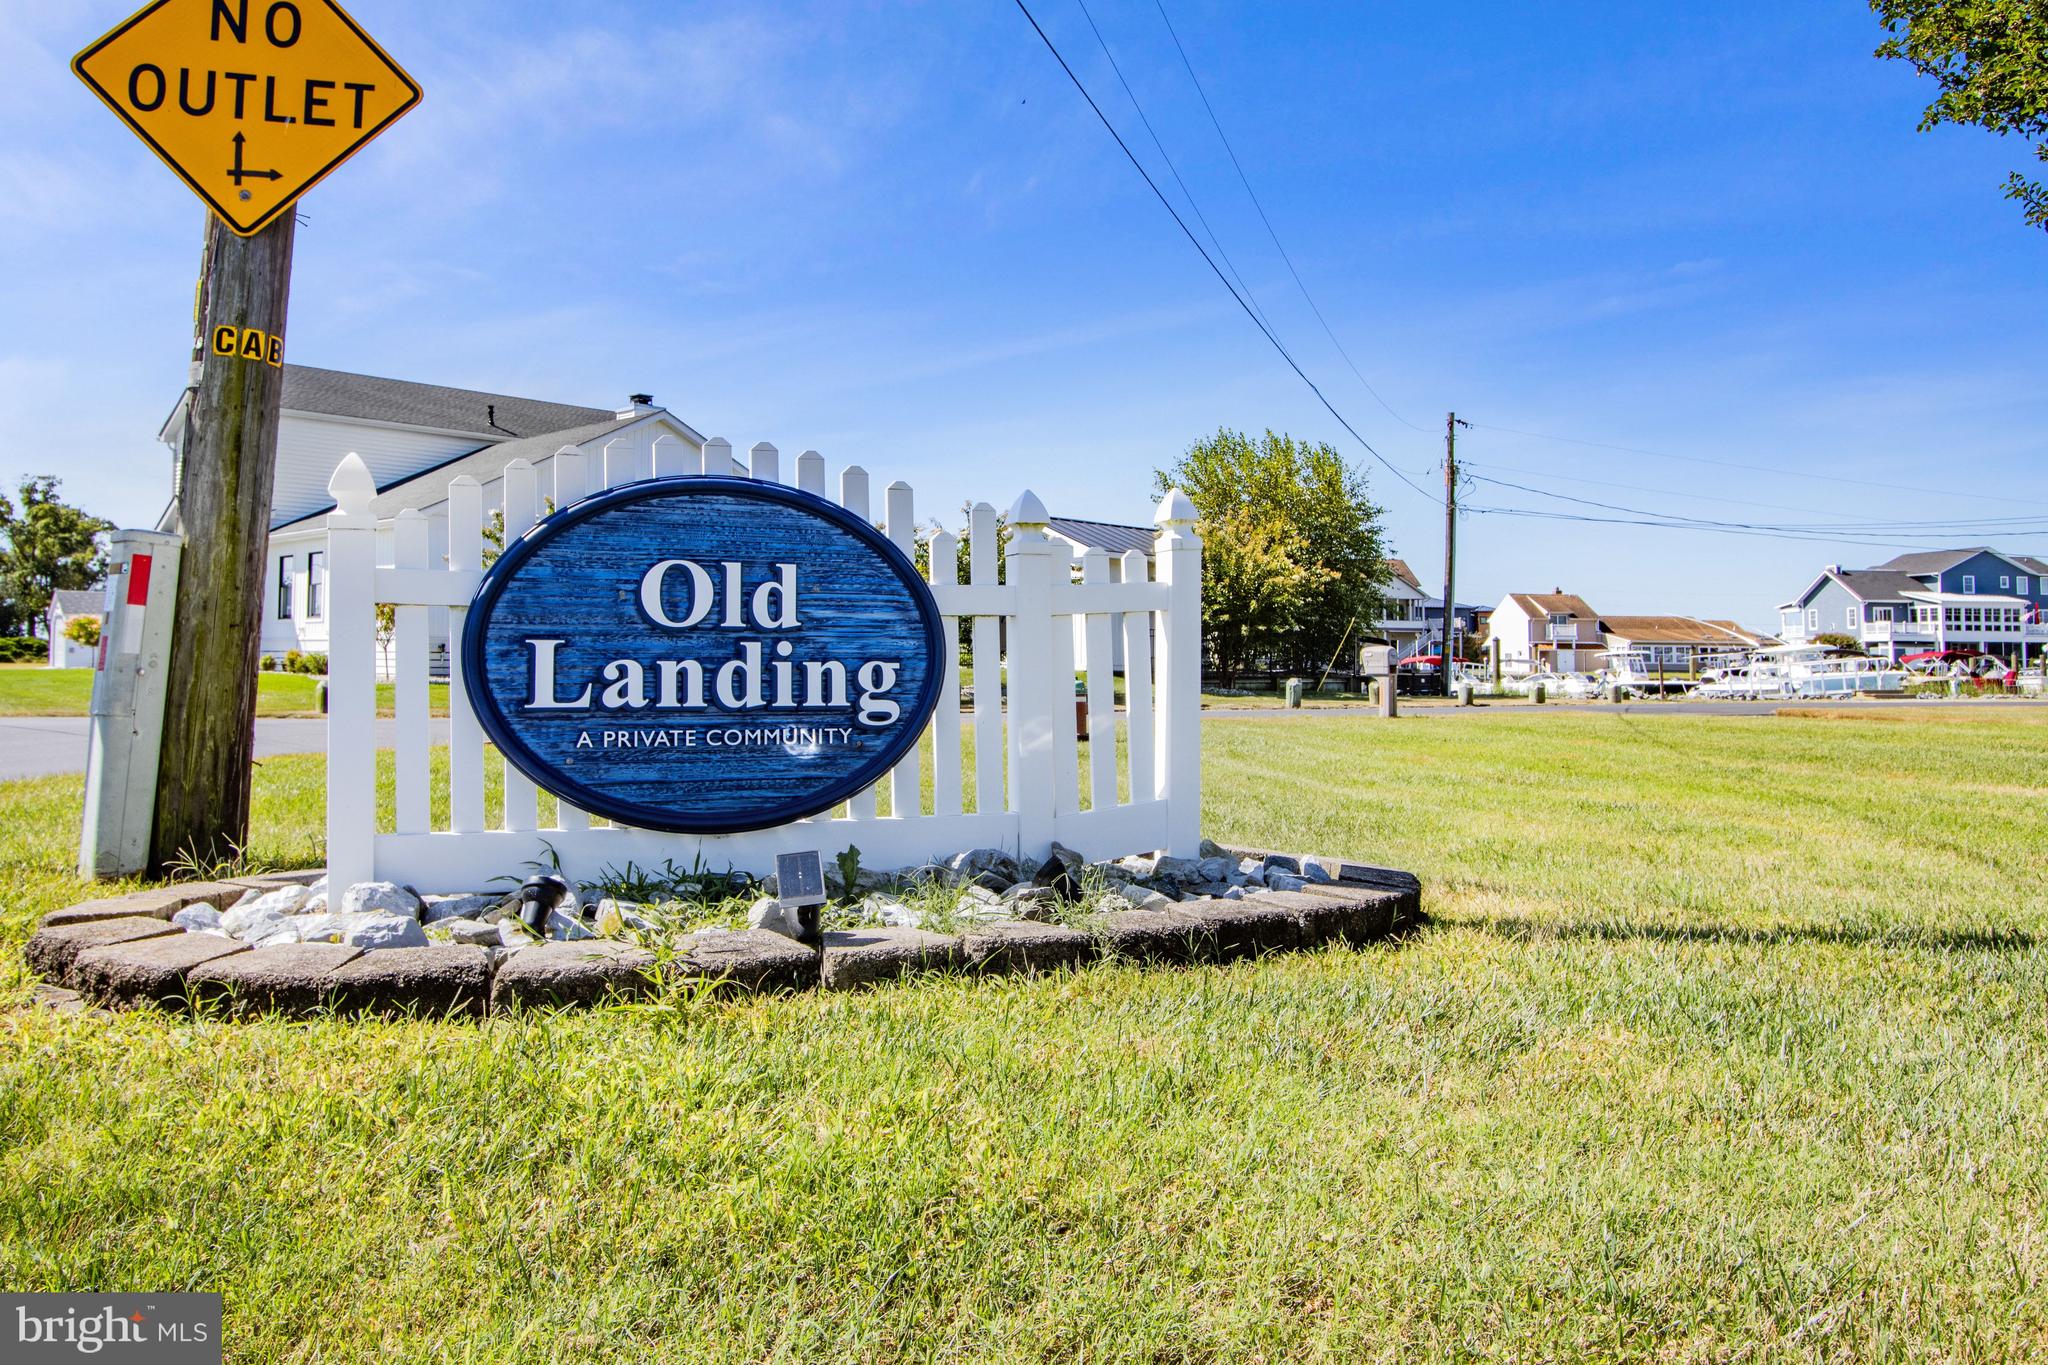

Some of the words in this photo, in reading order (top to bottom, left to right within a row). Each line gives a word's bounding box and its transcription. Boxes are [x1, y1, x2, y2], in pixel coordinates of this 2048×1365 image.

[210, 0, 302, 48] NO
[128, 63, 376, 129] OUTLET
[215, 327, 283, 362] CAB
[640, 558, 802, 630] Old
[524, 639, 901, 727] Landing
[576, 731, 593, 748] A
[603, 730, 697, 747] PRIVATE
[706, 728, 853, 746] COMMUNITY
